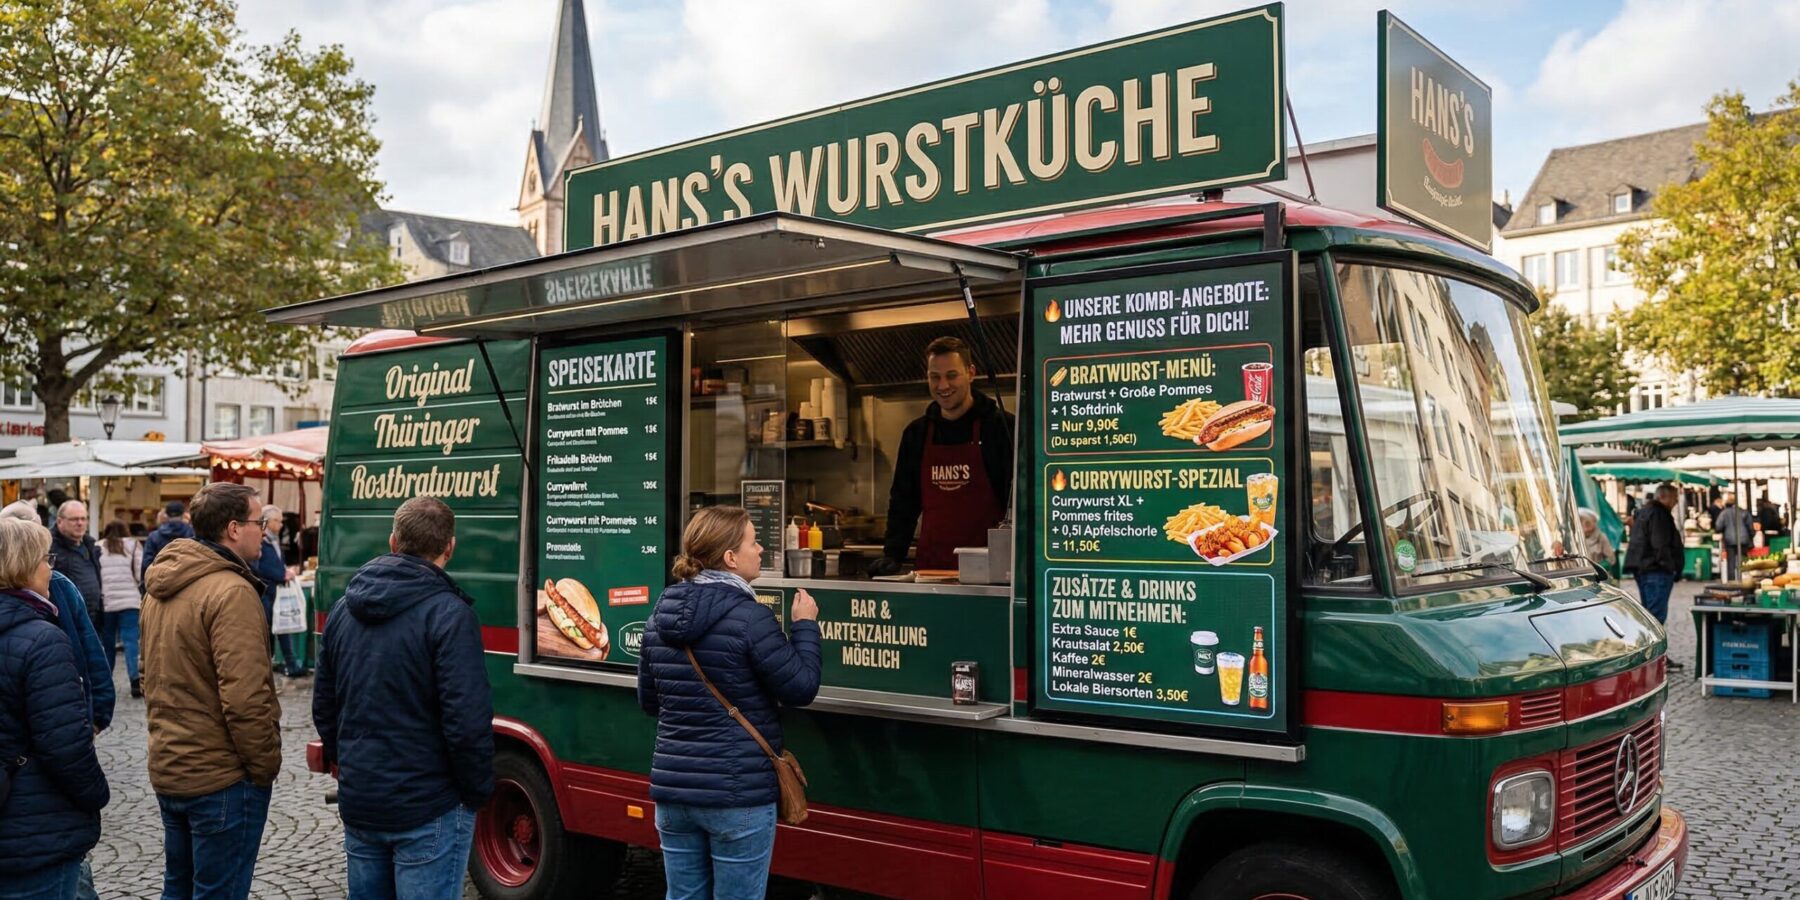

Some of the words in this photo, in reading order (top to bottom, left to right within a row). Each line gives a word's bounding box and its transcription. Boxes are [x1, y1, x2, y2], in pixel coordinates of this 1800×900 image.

[1411, 66, 1474, 157] HANS'S
[593, 154, 753, 247] HANS'S
[769, 62, 1220, 217] WURSTKÜCHE
[1065, 295, 1121, 319] UNSERE
[1126, 281, 1270, 314] KOMBI-ANGEBOTE:
[1060, 323, 1102, 345] MEHR
[1106, 318, 1166, 341] GENUSS
[1170, 312, 1201, 336] FÜR
[1206, 310, 1249, 333] DICH!
[548, 350, 656, 387] SPEISEKARTE
[1070, 353, 1216, 386] BRATWURST-MENÜ:
[386, 358, 475, 407] Original
[1051, 390, 1106, 402] Bratwurst
[1109, 390, 1117, 398] +
[1120, 386, 1156, 398] Große
[1160, 384, 1213, 396] Pommes
[1051, 408, 1059, 416] +
[1061, 406, 1067, 416] 1
[1071, 402, 1124, 416] Softdrink
[374, 412, 480, 455] Thüringer
[598, 426, 628, 436] Pommes
[1062, 420, 1084, 432] Nur
[1086, 419, 1119, 434] 9,90€
[1051, 436, 1068, 449] (Du
[1070, 435, 1102, 448] sparst
[1104, 433, 1137, 446] 1,50€!)
[351, 463, 500, 500] Rostbratwurst
[932, 464, 970, 480] HANS'S
[1070, 468, 1244, 490] CURRYWURST-SPEZIAL
[1052, 495, 1115, 510] Currywurst
[1118, 495, 1133, 506] XL
[1052, 510, 1102, 522] Pommes
[1104, 509, 1134, 522] frites
[1052, 527, 1060, 535] +
[1084, 524, 1158, 539] Apfelschorle
[1052, 542, 1060, 550] =
[1062, 540, 1101, 555] 11,50€
[1052, 574, 1116, 598] ZUSÄTZE
[1121, 580, 1134, 599] &
[1139, 580, 1196, 602] DRINKS
[851, 598, 876, 618] BAR
[880, 600, 892, 620] &
[1052, 599, 1084, 620] ZUM
[1089, 600, 1187, 624] MITNEHMEN:
[1052, 624, 1081, 636] Extra
[1084, 626, 1120, 638] Sauce
[1122, 626, 1137, 638] 1€
[842, 643, 900, 670] MÖGLICH
[1052, 638, 1110, 652] Krautsalat
[1113, 640, 1145, 655] 2,50€
[1052, 652, 1089, 665] Kaffee
[1091, 654, 1106, 666] 2€
[1052, 666, 1136, 683] Mineralwasser
[1138, 672, 1153, 684] 2€
[1052, 681, 1090, 694] Lokale
[1092, 684, 1153, 700] Biersorten
[1156, 688, 1189, 702] 3,50€
